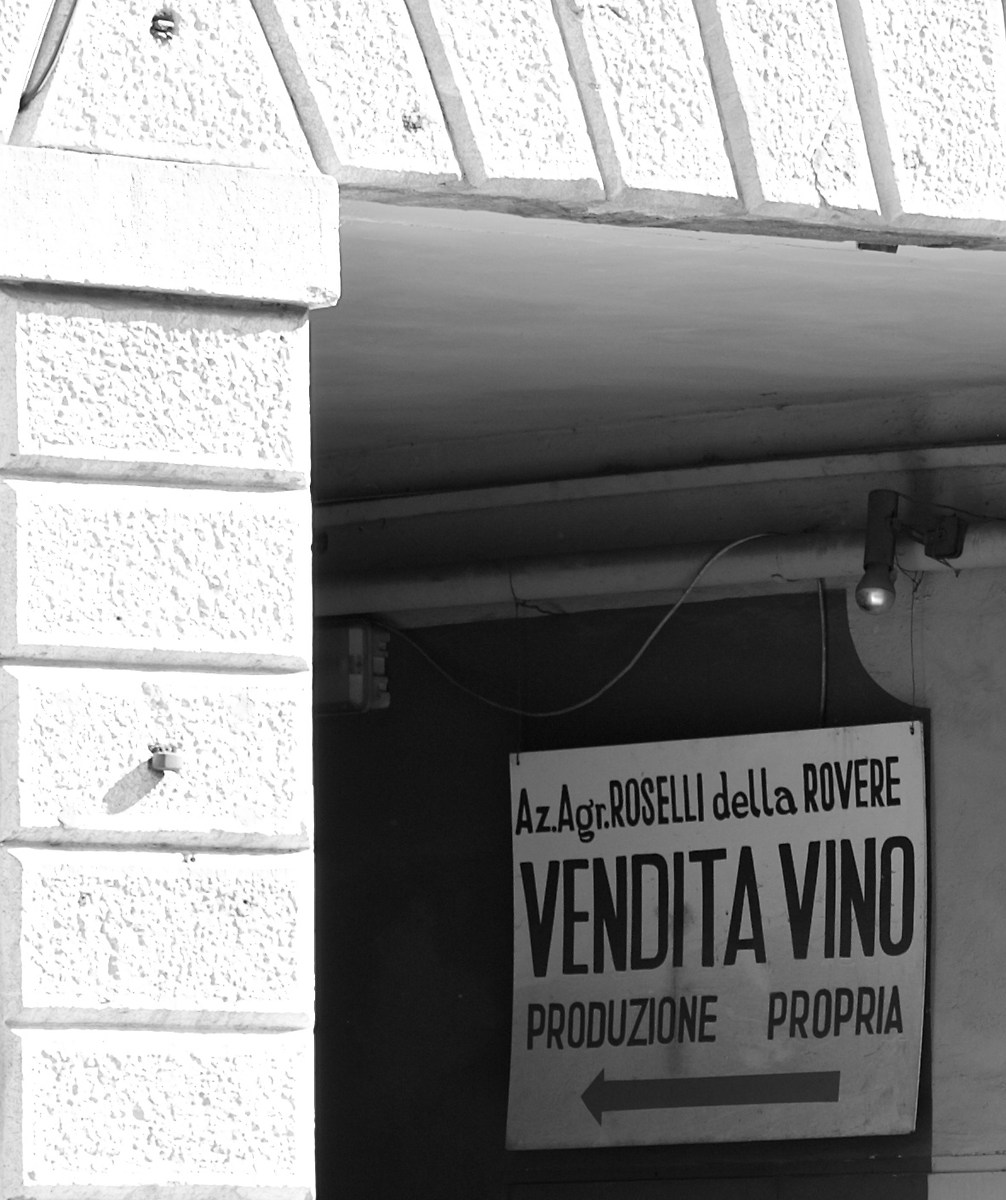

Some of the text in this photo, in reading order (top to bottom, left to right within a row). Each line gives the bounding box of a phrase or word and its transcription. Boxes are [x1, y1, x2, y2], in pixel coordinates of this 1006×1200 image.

[713, 767, 798, 821] della
[803, 756, 901, 813] ROVERE
[520, 835, 915, 978] VENDITA VINO
[527, 985, 903, 1050] PRODUZIONE PROPRIA
